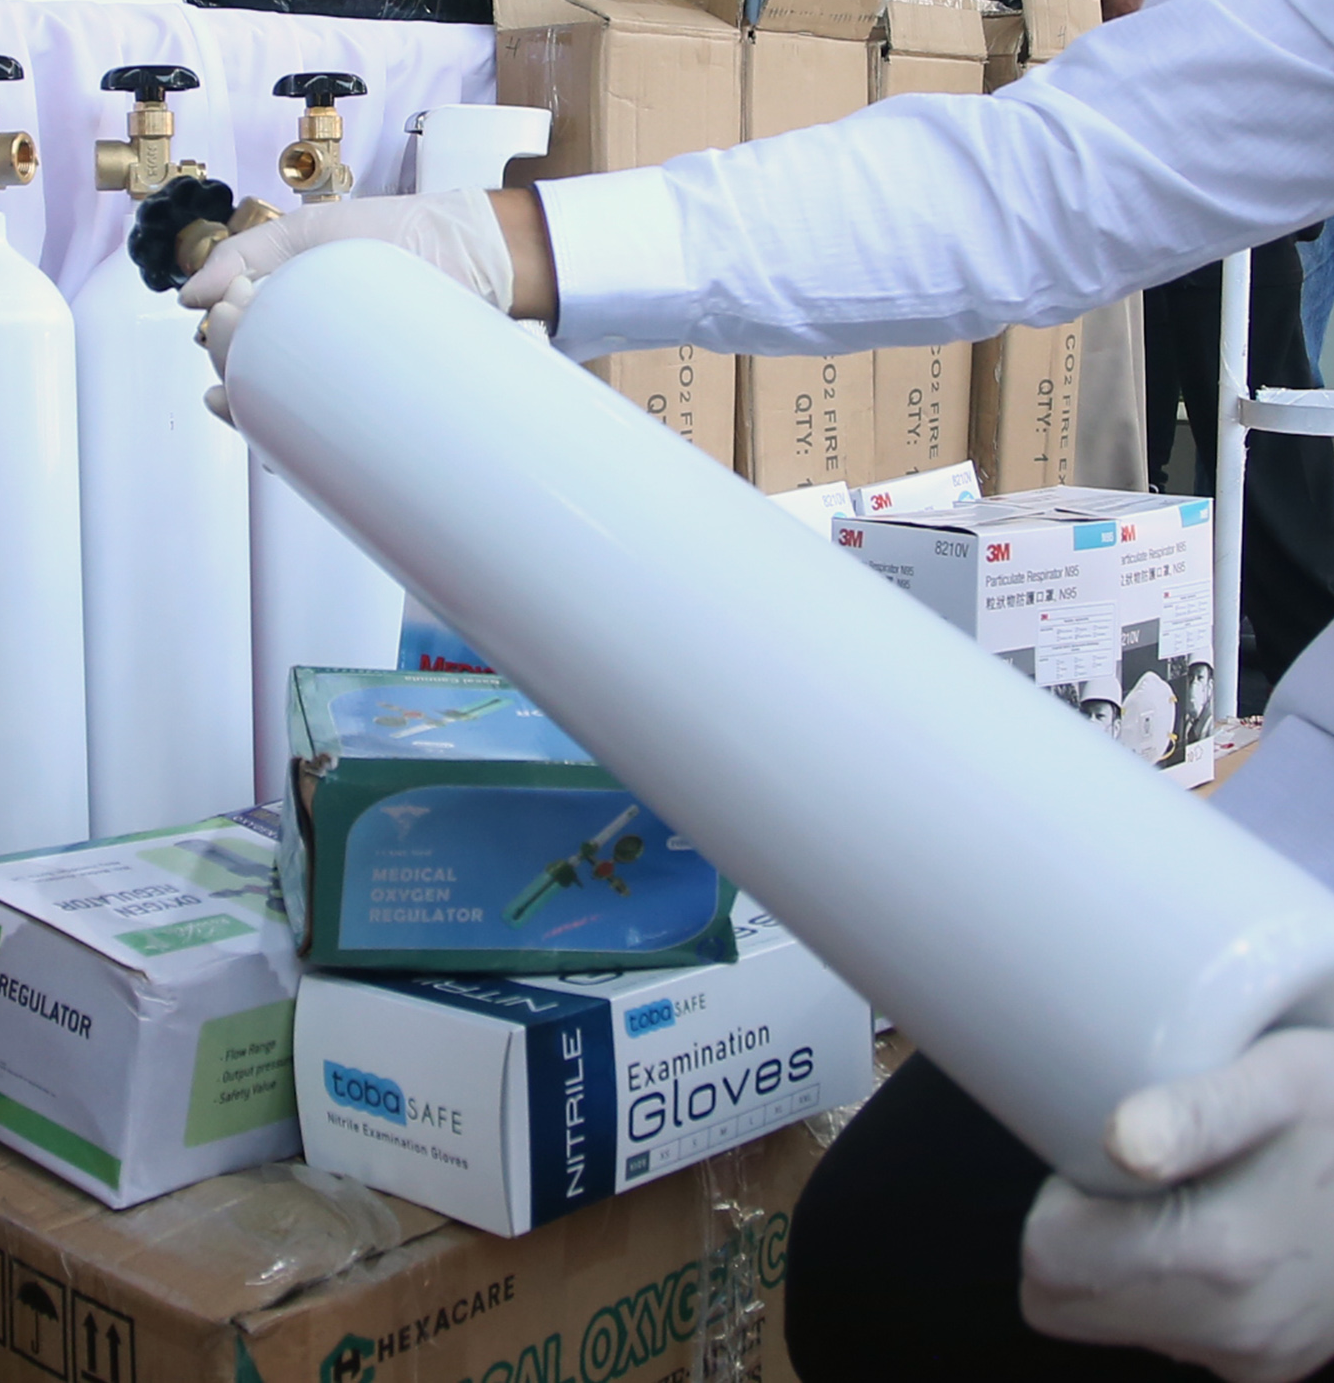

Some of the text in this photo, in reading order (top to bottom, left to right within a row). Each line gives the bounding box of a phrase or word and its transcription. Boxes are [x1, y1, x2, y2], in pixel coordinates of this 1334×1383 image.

[1063, 334, 1076, 386] CO2
[794, 393, 813, 457] QTY:
[906, 388, 922, 446] QTY:
[928, 401, 940, 460] FIRE
[1033, 378, 1054, 463] QTY: 1
[1059, 394, 1071, 450] FIRE
[823, 409, 839, 473] FIRE
[870, 492, 893, 511] 3M
[838, 528, 864, 549] 3M
[935, 540, 970, 558] 8210V
[985, 543, 1011, 563] 3M
[1121, 549, 1149, 565] articulate
[985, 565, 1080, 588] Particulate Respirator N95
[1058, 586, 1078, 601] N95
[1121, 630, 1141, 647] 210V
[370, 887, 451, 902] OXYGEN
[372, 867, 458, 883] MEDICAL
[53, 883, 181, 911] REGULATOR
[115, 893, 202, 917] OXYGEN
[369, 907, 484, 923] REGULATOR
[628, 993, 707, 1033] toba SAFE
[628, 1024, 771, 1093] Examination
[332, 1070, 463, 1136] toba SAFE
[562, 1027, 585, 1199] NITRILE
[628, 1046, 814, 1143] Gloves
[327, 1111, 469, 1170] Nitrile Examination Gloves
[376, 1274, 516, 1363] HEXACARE
